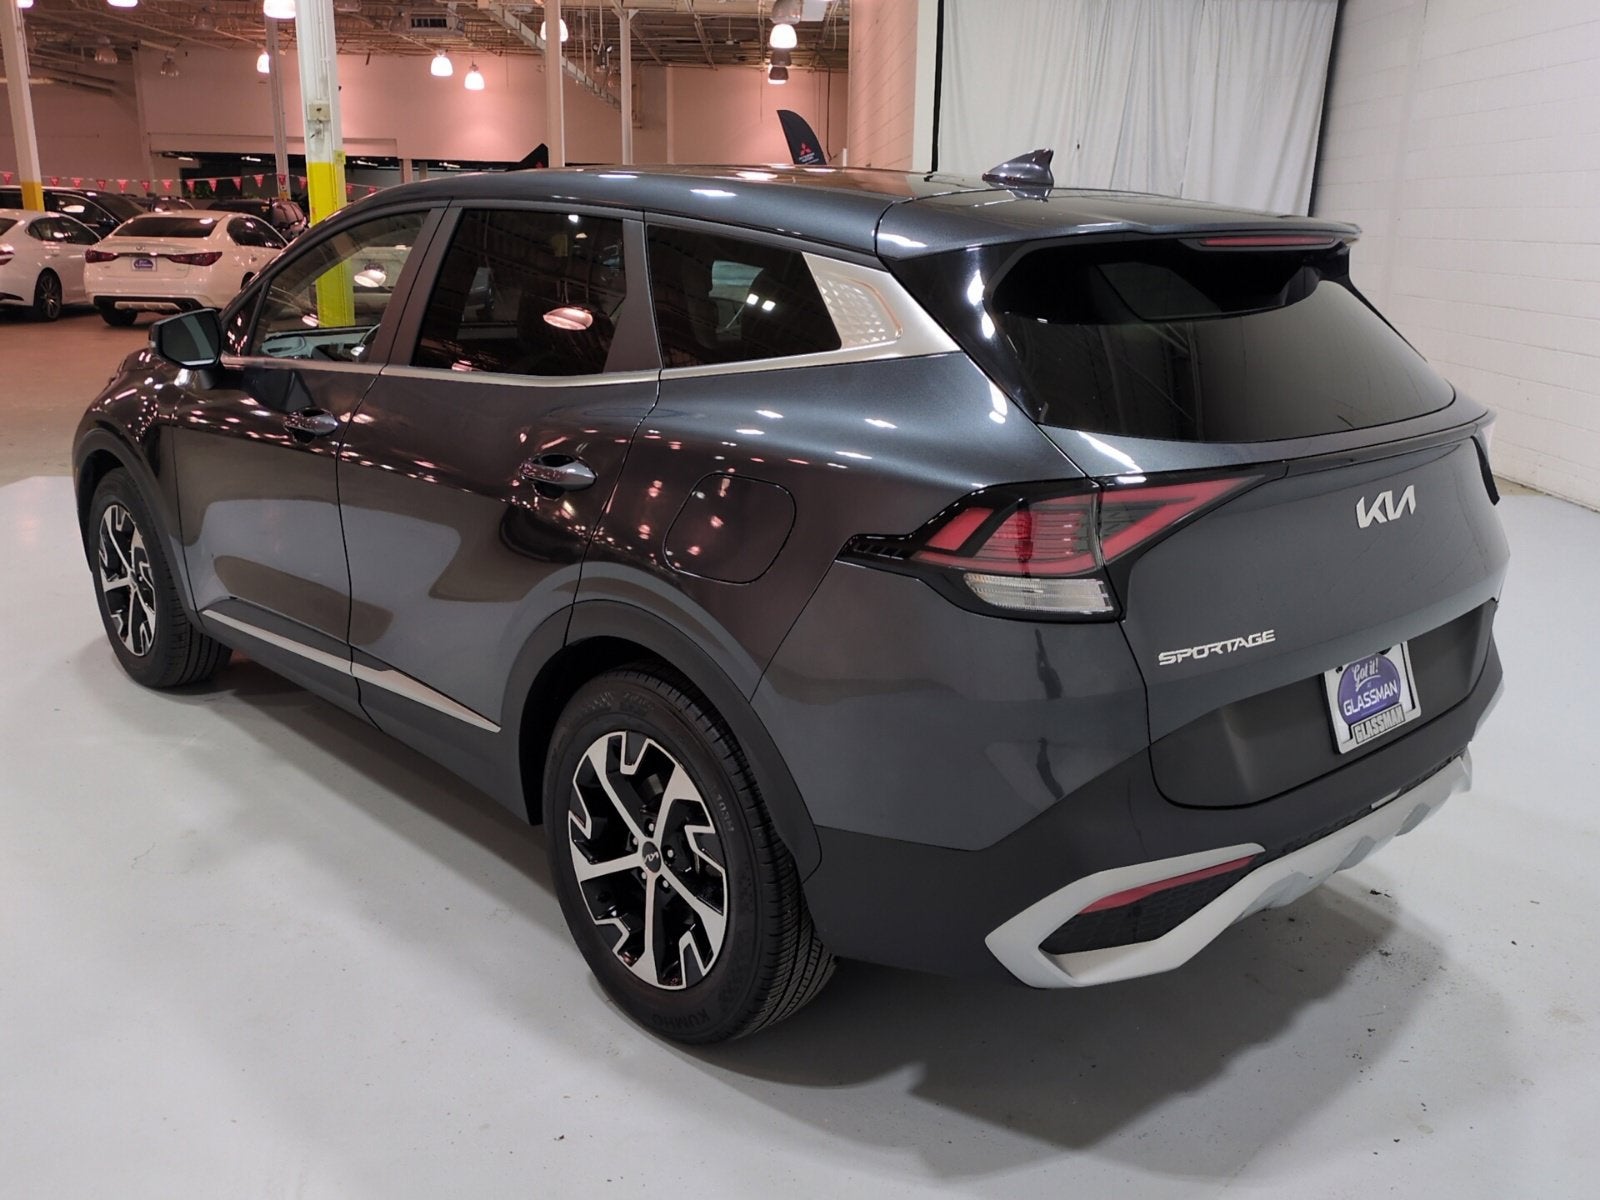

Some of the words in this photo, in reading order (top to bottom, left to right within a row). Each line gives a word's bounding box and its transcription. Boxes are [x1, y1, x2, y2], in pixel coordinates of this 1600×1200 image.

[1356, 484, 1416, 529] KIA
[1158, 629, 1276, 666] SPORTAGE
[1352, 662, 1369, 685] Got
[1369, 657, 1379, 675] it!
[1343, 680, 1398, 716] GLASSMAN
[1354, 706, 1404, 742] GLASSMAN
